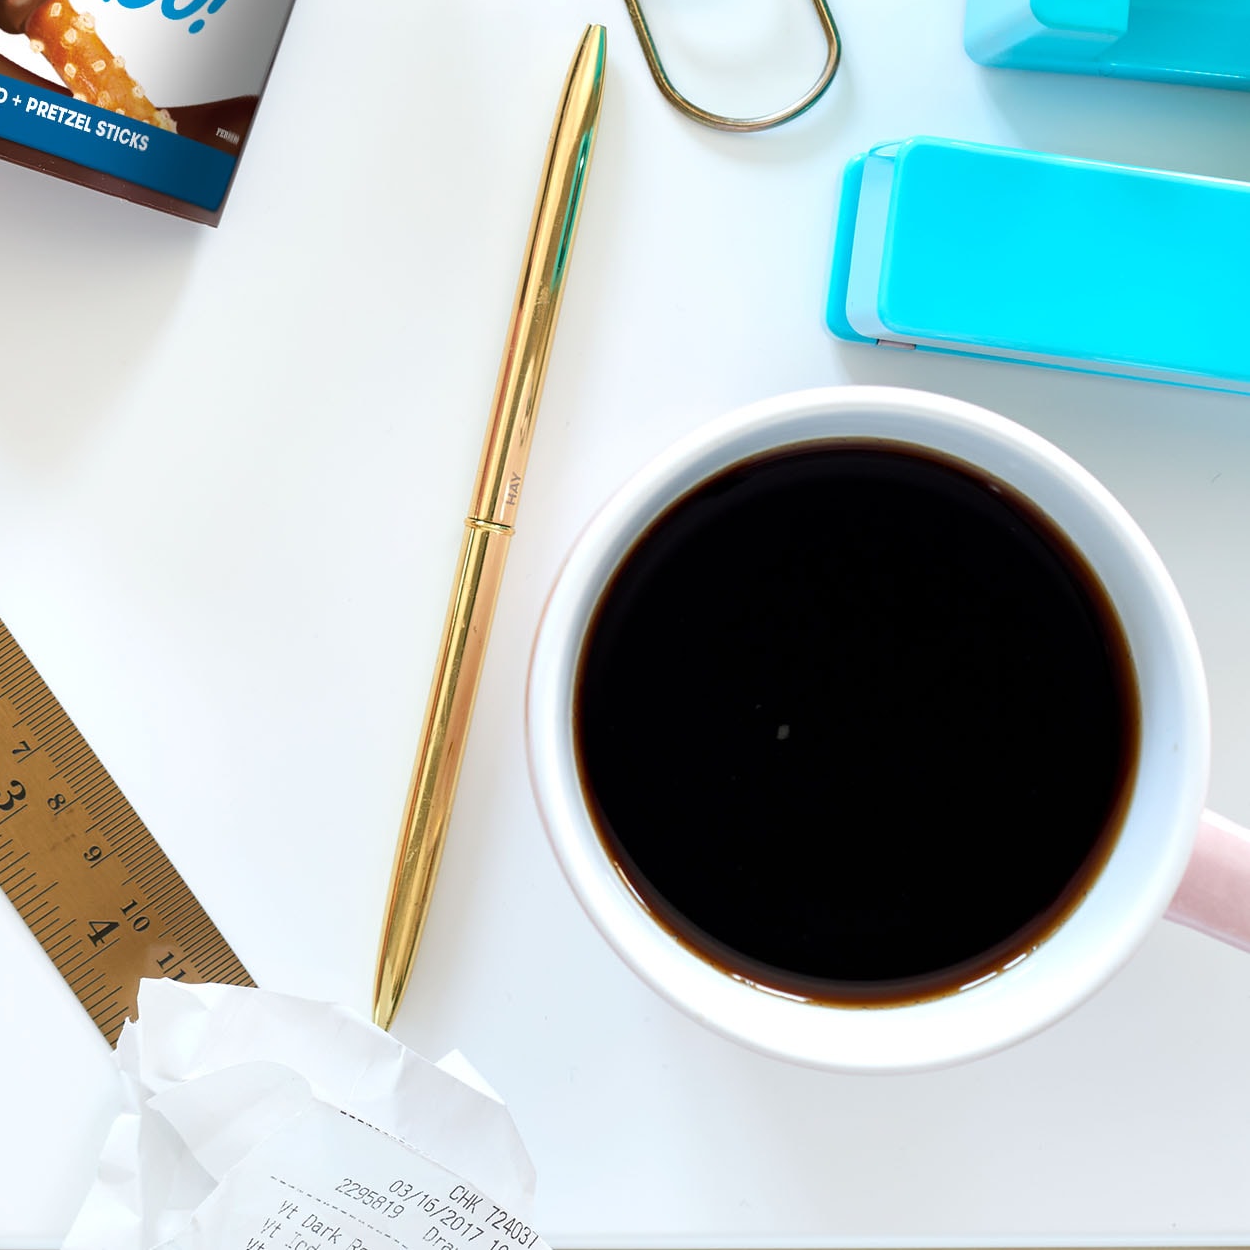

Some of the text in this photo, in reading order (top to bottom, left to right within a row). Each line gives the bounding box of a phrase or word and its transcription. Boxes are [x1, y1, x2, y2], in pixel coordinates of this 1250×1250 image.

[25, 97, 92, 135] PRETZEL
[95, 119, 151, 152] STICKS
[506, 471, 521, 506] HAY
[11, 739, 31, 756] 7
[47, 793, 66, 812] 8
[83, 845, 103, 864] 9
[120, 898, 150, 932] 10
[88, 916, 119, 947] 4
[334, 1178, 405, 1219] 2295819
[388, 1179, 485, 1242] 03/16/2017
[448, 1184, 484, 1214] CHK
[301, 1213, 343, 1244] Dark
